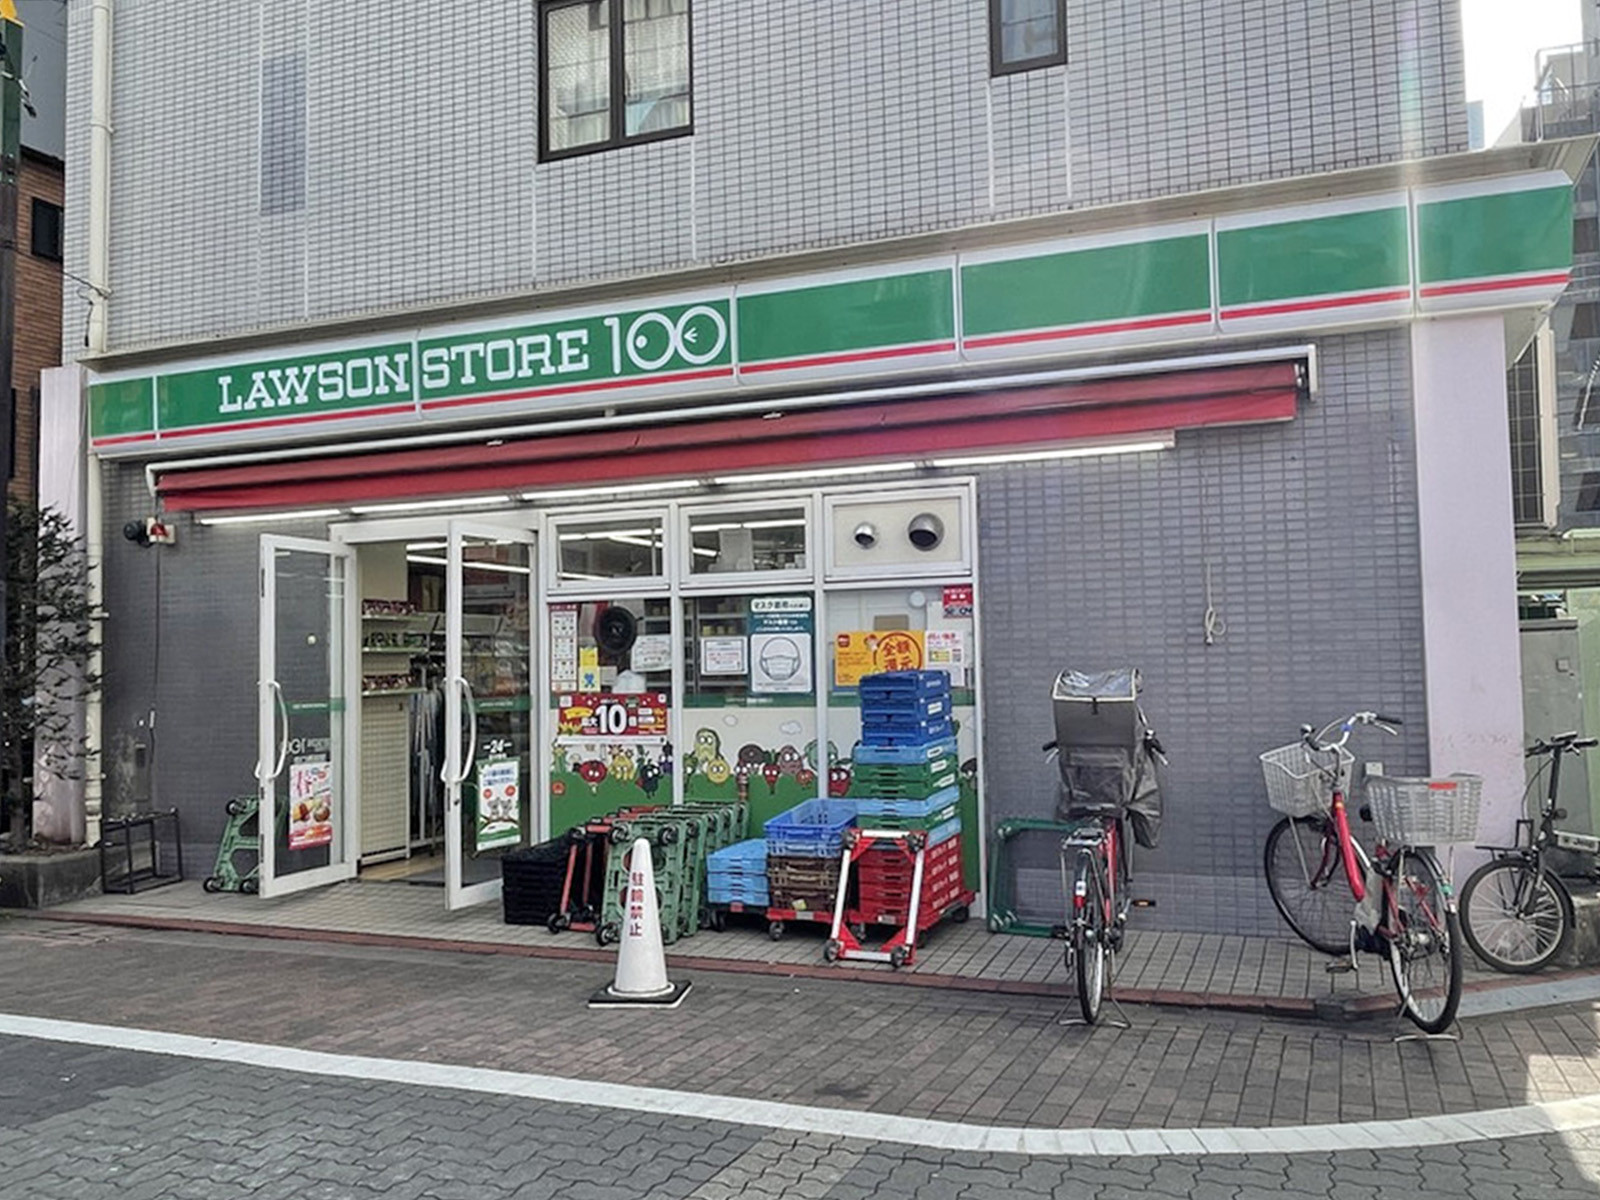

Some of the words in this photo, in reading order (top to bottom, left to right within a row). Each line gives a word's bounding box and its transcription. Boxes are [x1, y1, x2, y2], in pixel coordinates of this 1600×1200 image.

[218, 353, 410, 413] LAWSON
[421, 328, 590, 388] STORE
[603, 306, 728, 375] 100
[595, 704, 628, 734] 10
[629, 871, 645, 937] 駐輪禁止
